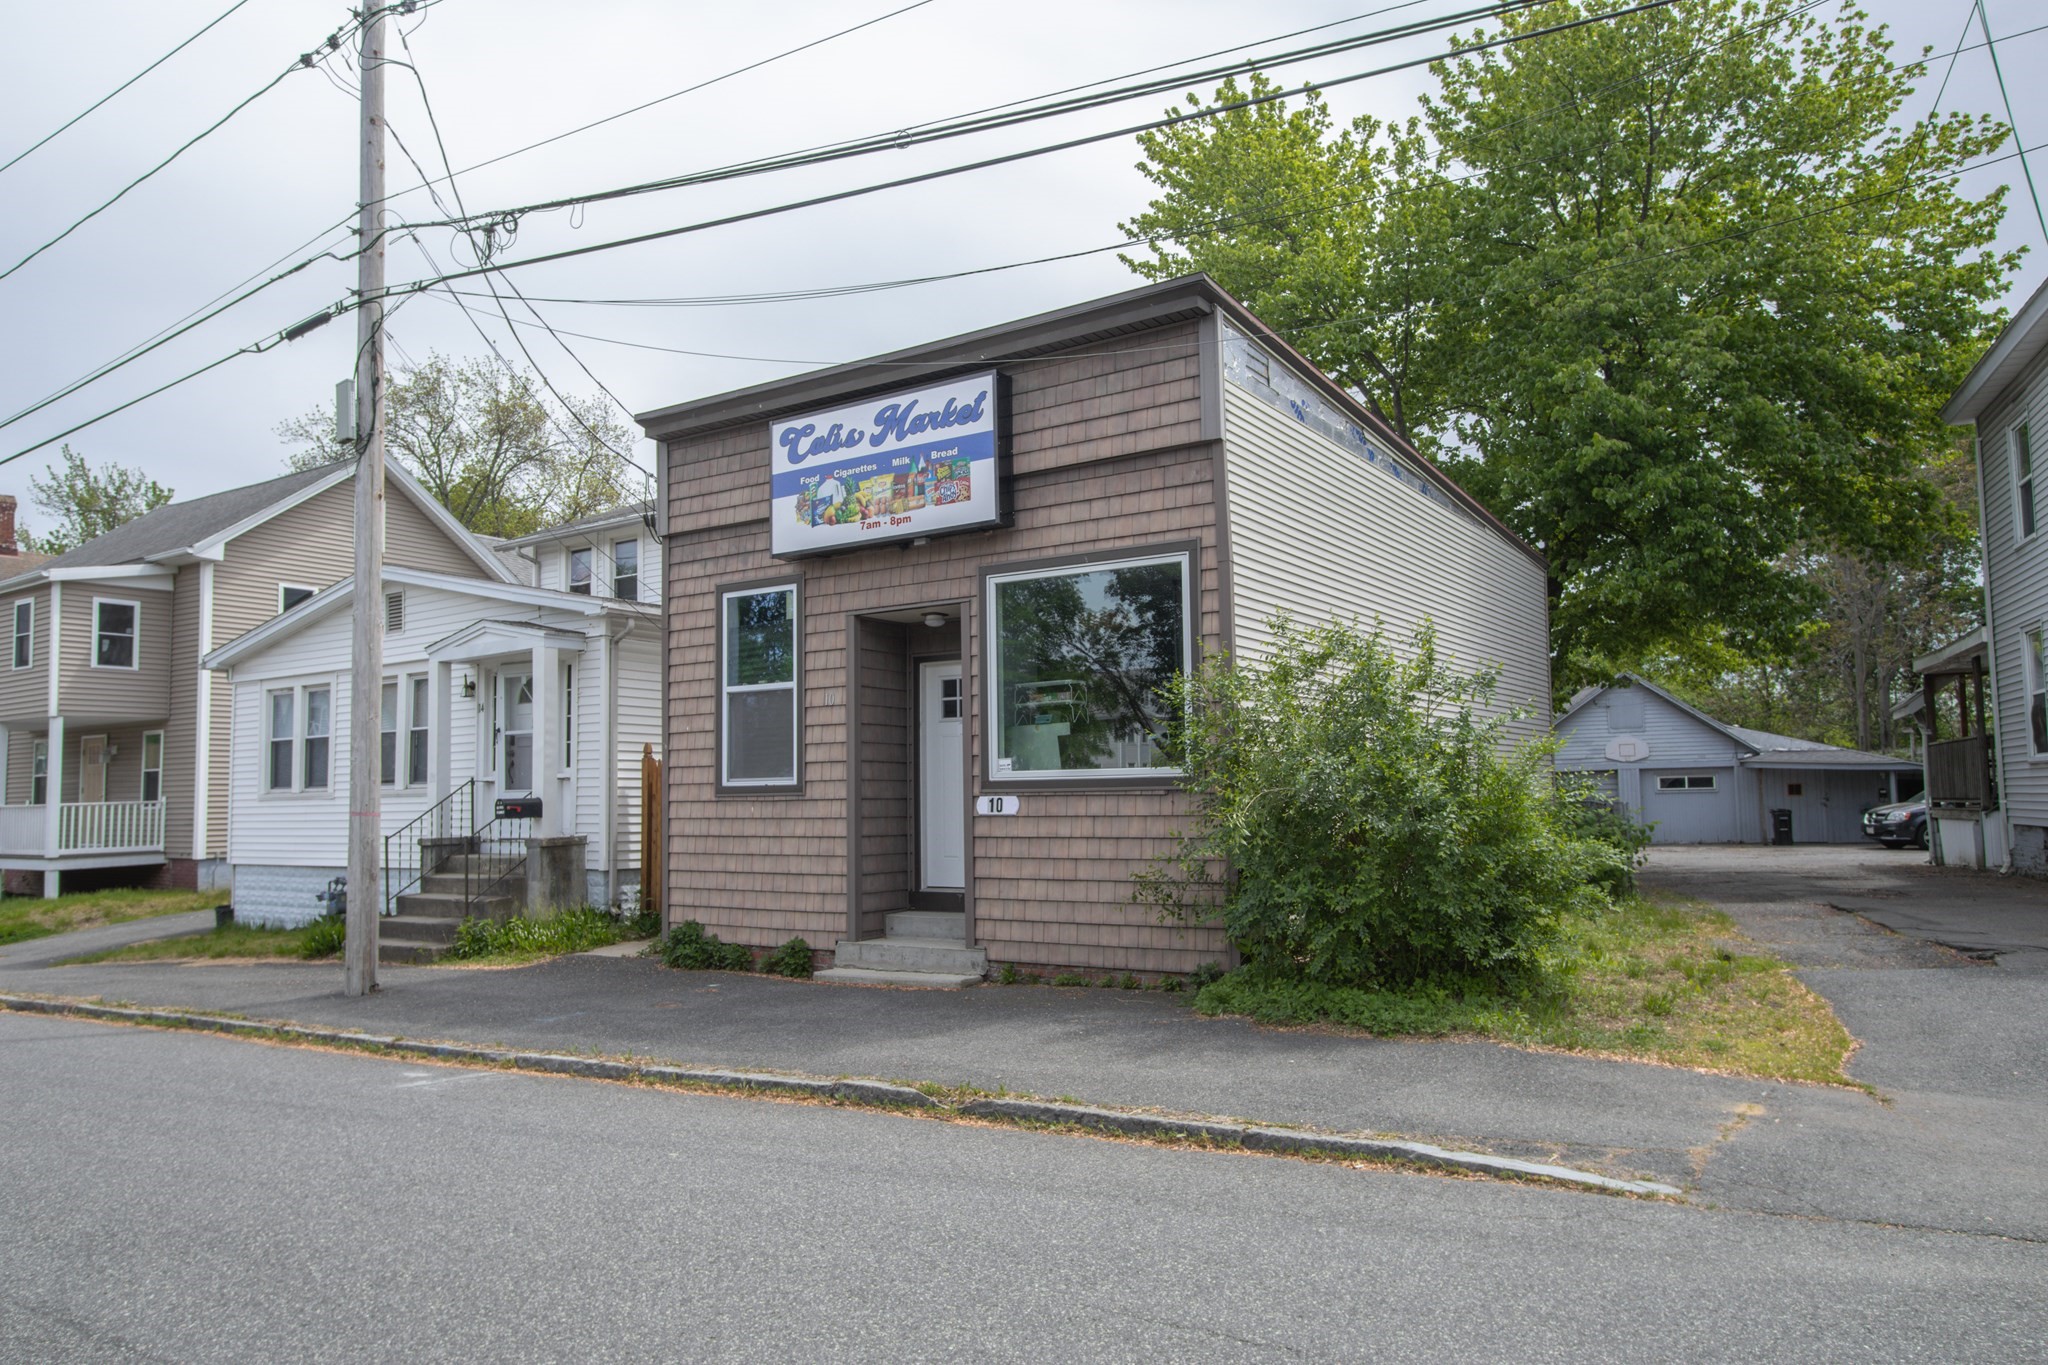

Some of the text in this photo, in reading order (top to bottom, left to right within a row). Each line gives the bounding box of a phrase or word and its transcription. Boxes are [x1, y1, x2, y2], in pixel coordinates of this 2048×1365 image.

[868, 390, 988, 447] Market
[800, 474, 820, 485] Food
[833, 462, 877, 478] Cigarettes
[892, 457, 911, 467] Milk
[931, 447, 958, 460] Bread
[860, 520, 881, 531] 7am
[890, 515, 912, 528] 8pm
[989, 796, 1003, 813] 10
